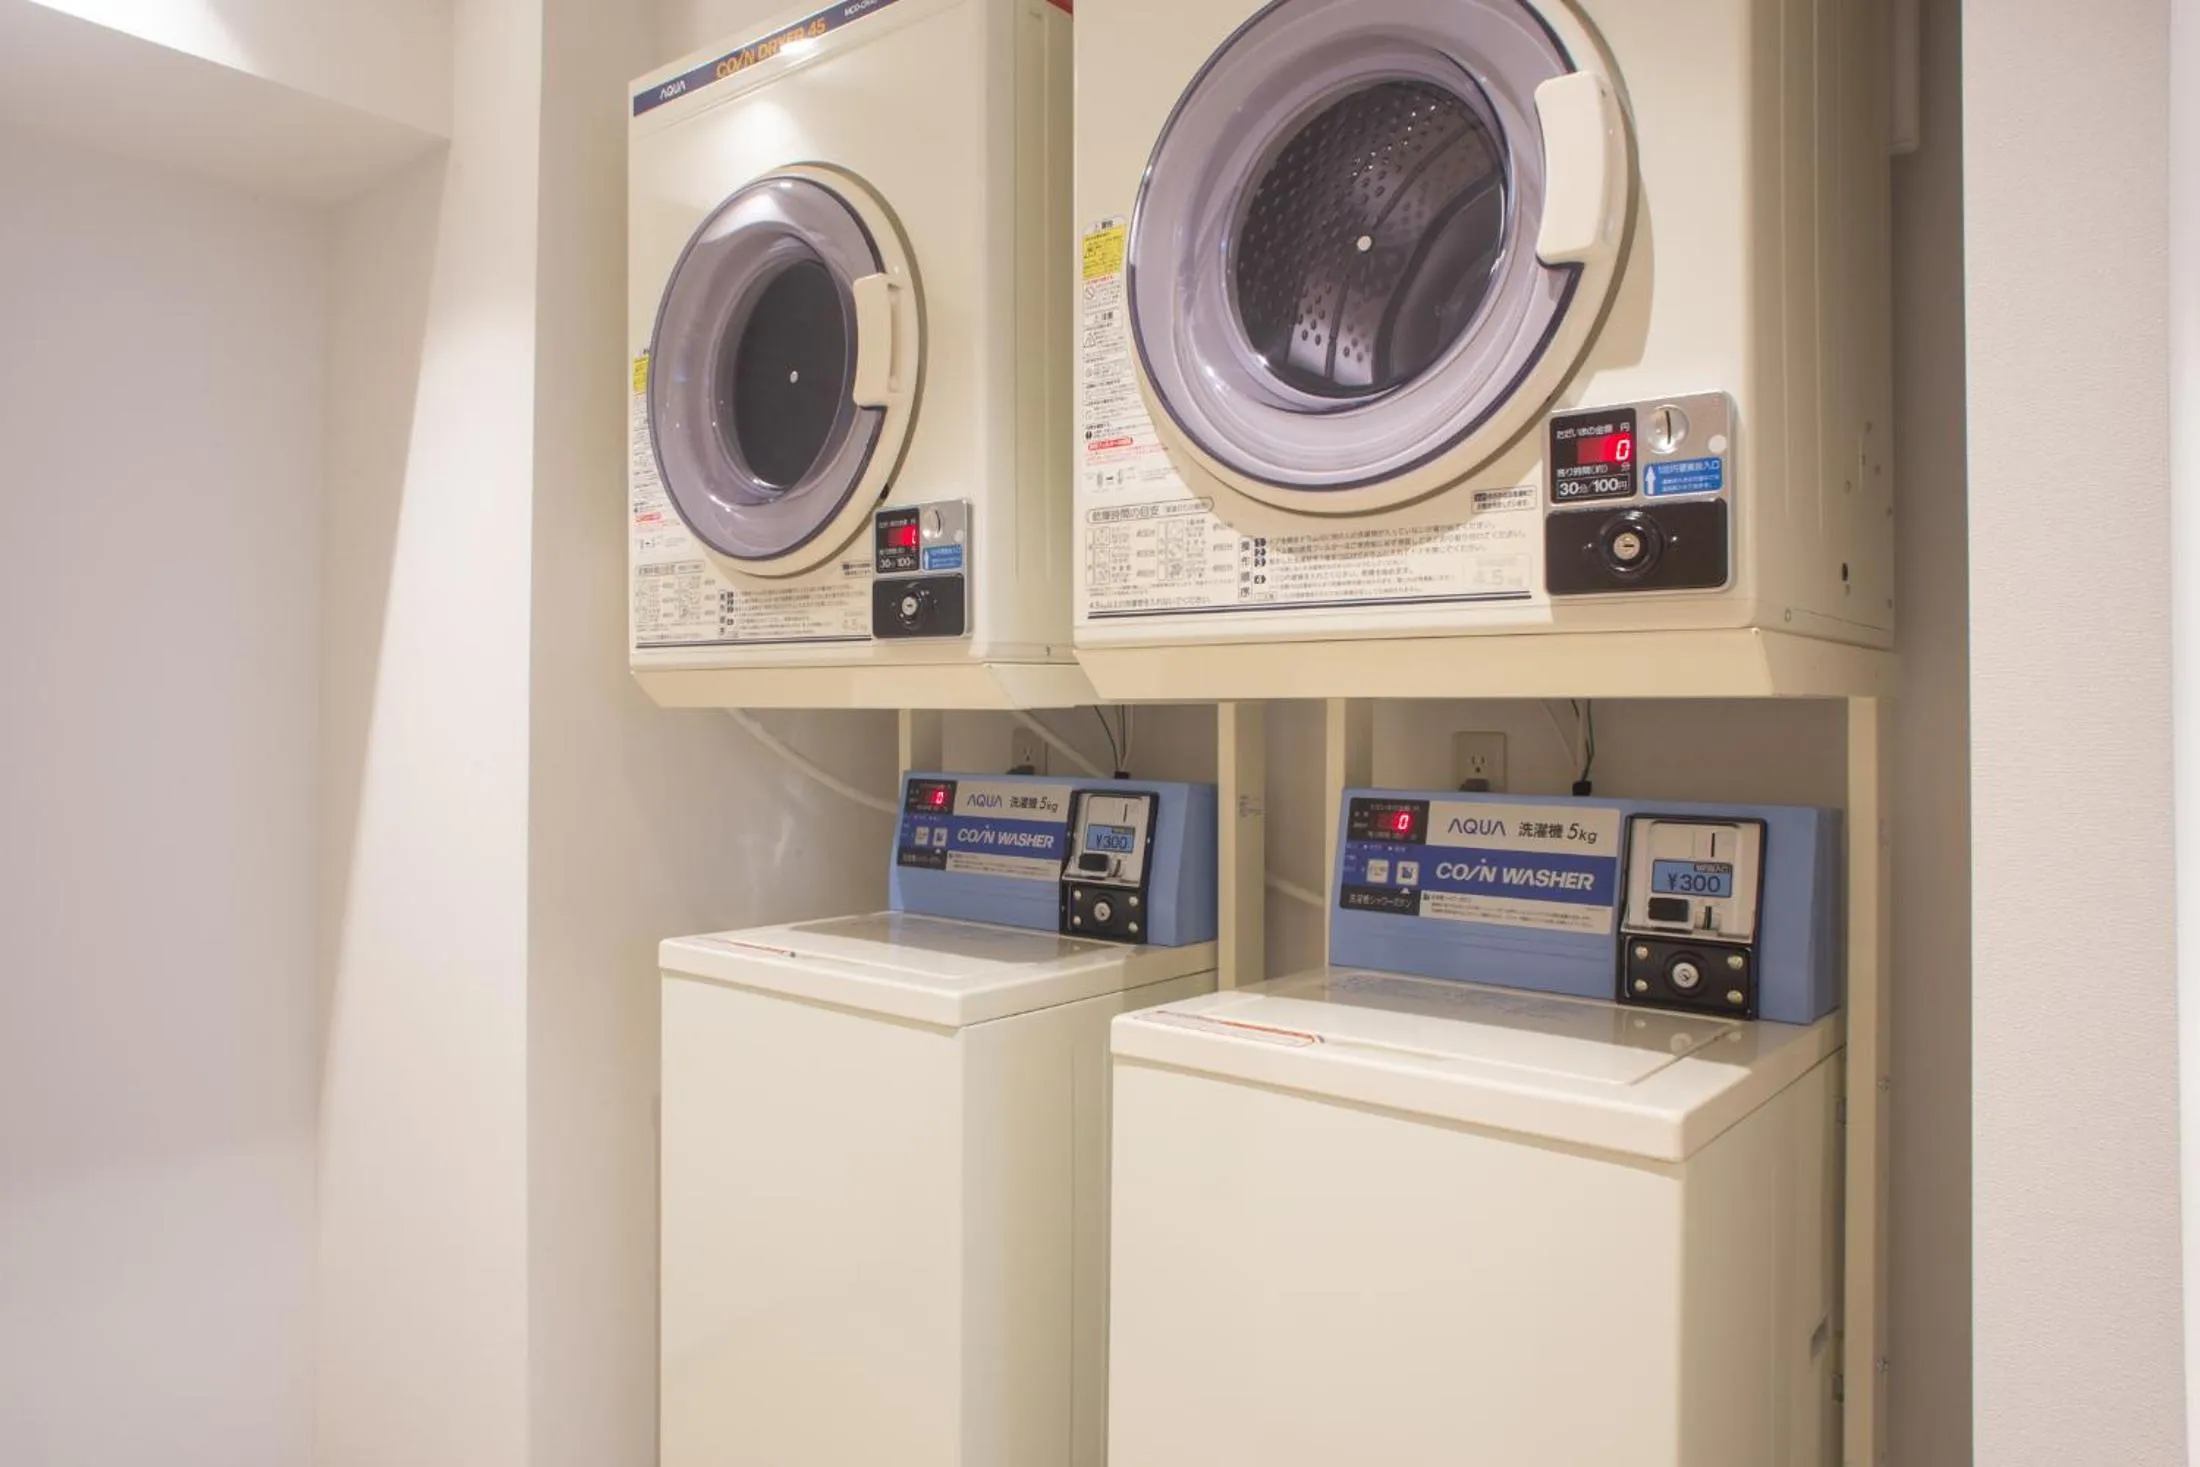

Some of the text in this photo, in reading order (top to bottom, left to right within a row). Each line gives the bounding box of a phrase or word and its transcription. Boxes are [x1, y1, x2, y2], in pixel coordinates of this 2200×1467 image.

[659, 80, 687, 100] AQUA
[807, 18, 826, 37] 45
[1615, 439, 1630, 461] 0
[967, 793, 1059, 813] AQUA 洗濯機 5kg
[1397, 814, 1409, 830] 0
[1448, 818, 1598, 844] AQUA 洗濯機 5kg
[957, 825, 1054, 849] COIN WASHER
[1096, 833, 1128, 850] ¥300
[1436, 858, 1497, 883] COIN
[1502, 867, 1595, 891] WASHER
[1667, 873, 1721, 893] ¥300
